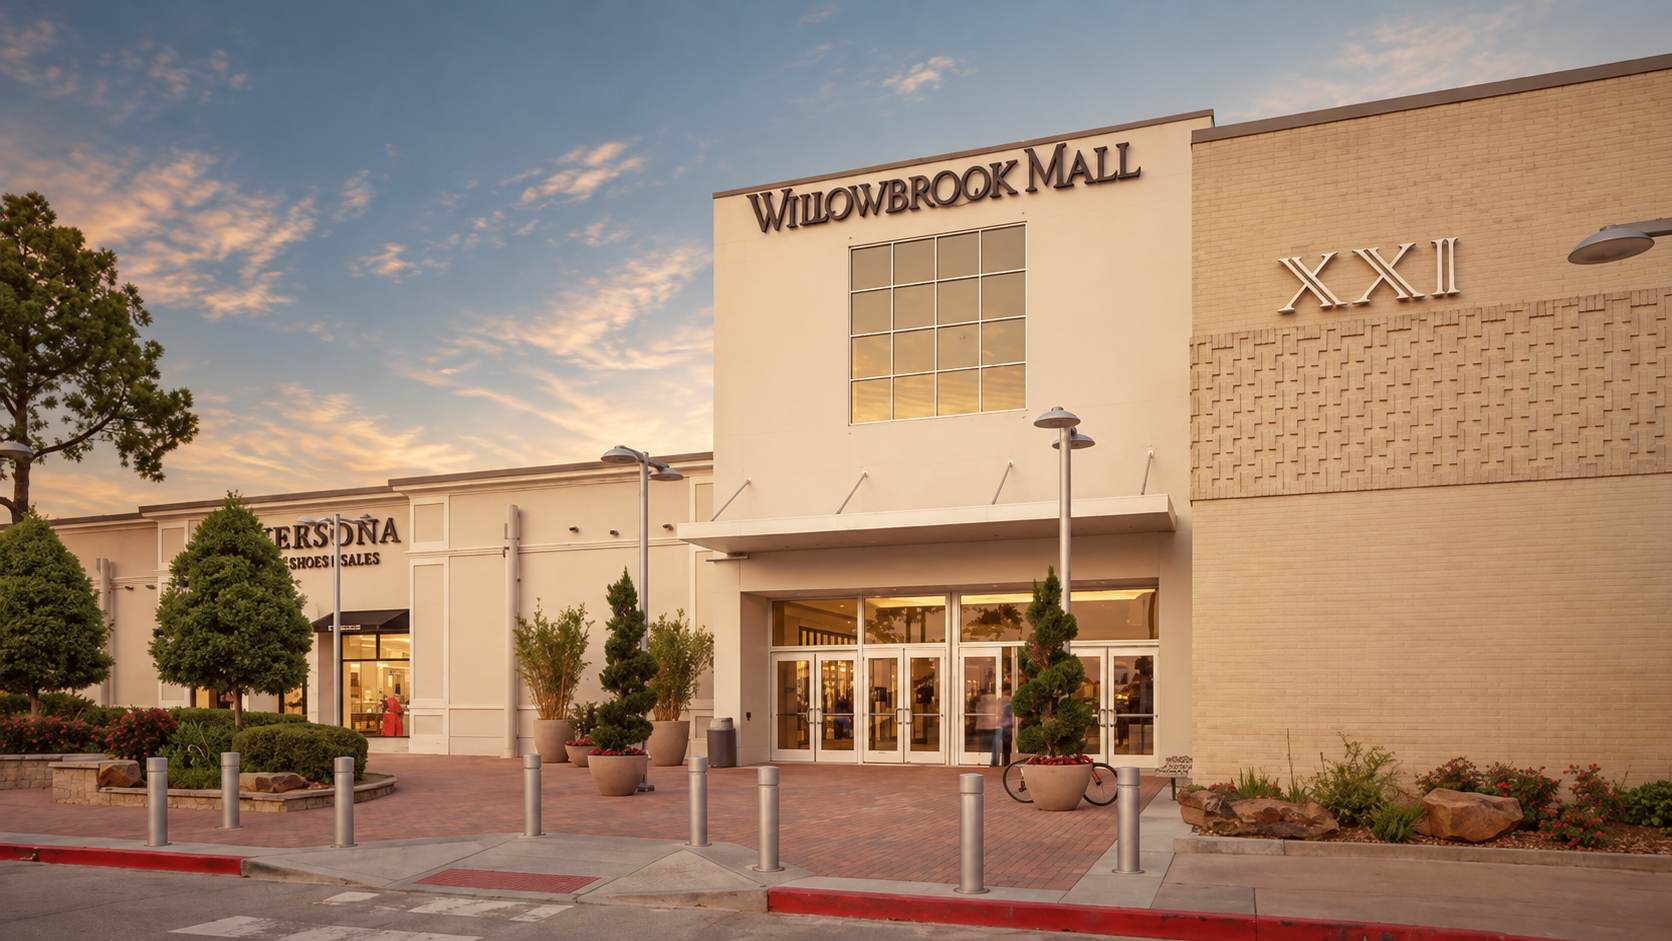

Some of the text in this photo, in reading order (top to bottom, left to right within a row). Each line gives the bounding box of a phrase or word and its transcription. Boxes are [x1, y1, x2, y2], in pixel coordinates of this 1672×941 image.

[746, 142, 1142, 233] WILLOWBROOK MALL
[1277, 237, 1461, 313] XXI
[263, 517, 401, 550] ERSONA
[289, 555, 329, 569] SHOES
[340, 552, 380, 566] SALES
